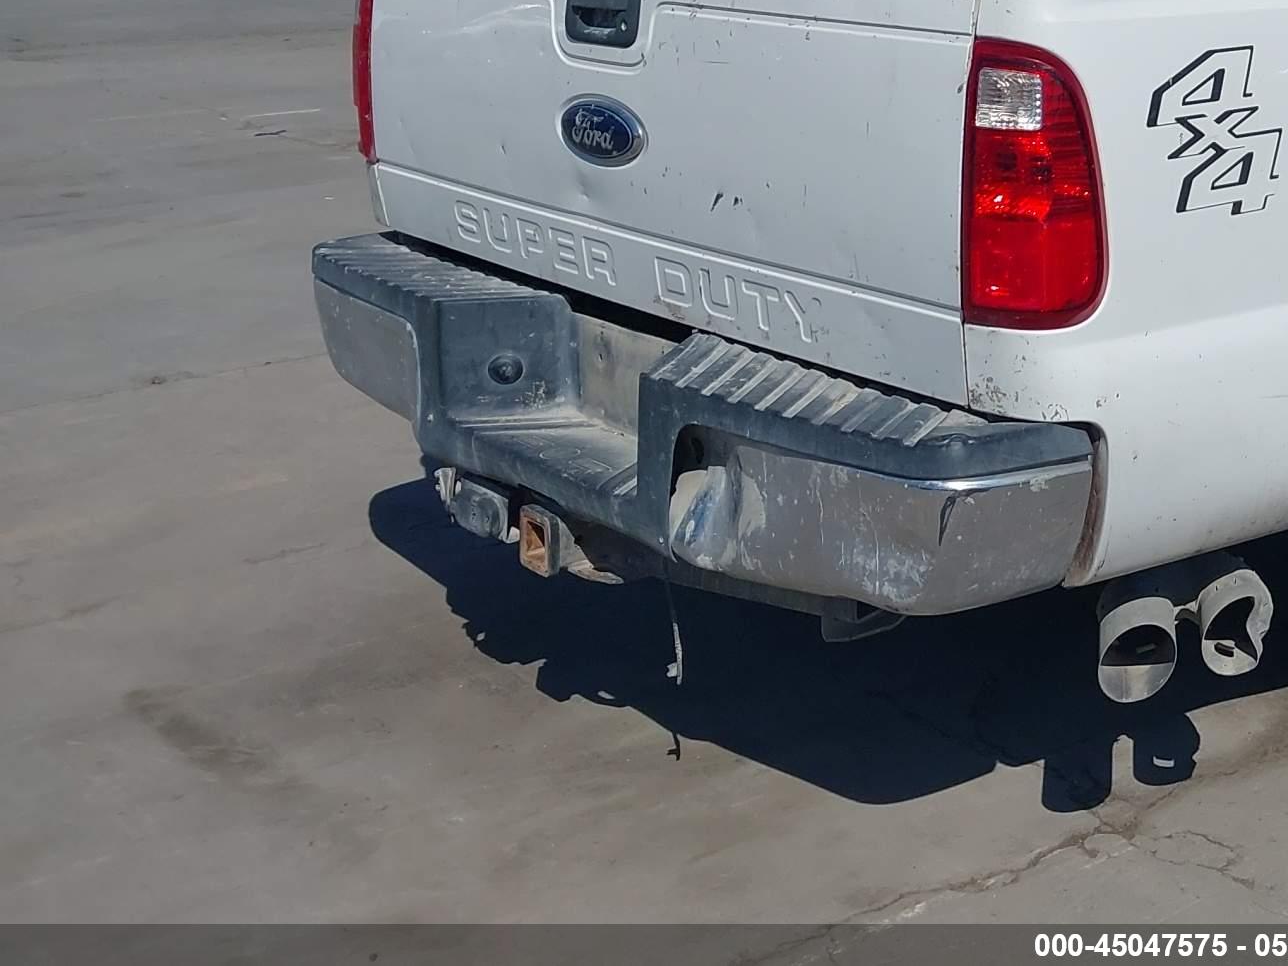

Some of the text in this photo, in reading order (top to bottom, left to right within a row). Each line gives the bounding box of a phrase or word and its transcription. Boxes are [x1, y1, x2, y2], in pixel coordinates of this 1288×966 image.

[571, 108, 615, 150] Ford
[453, 199, 822, 343] SUPER DUTY
